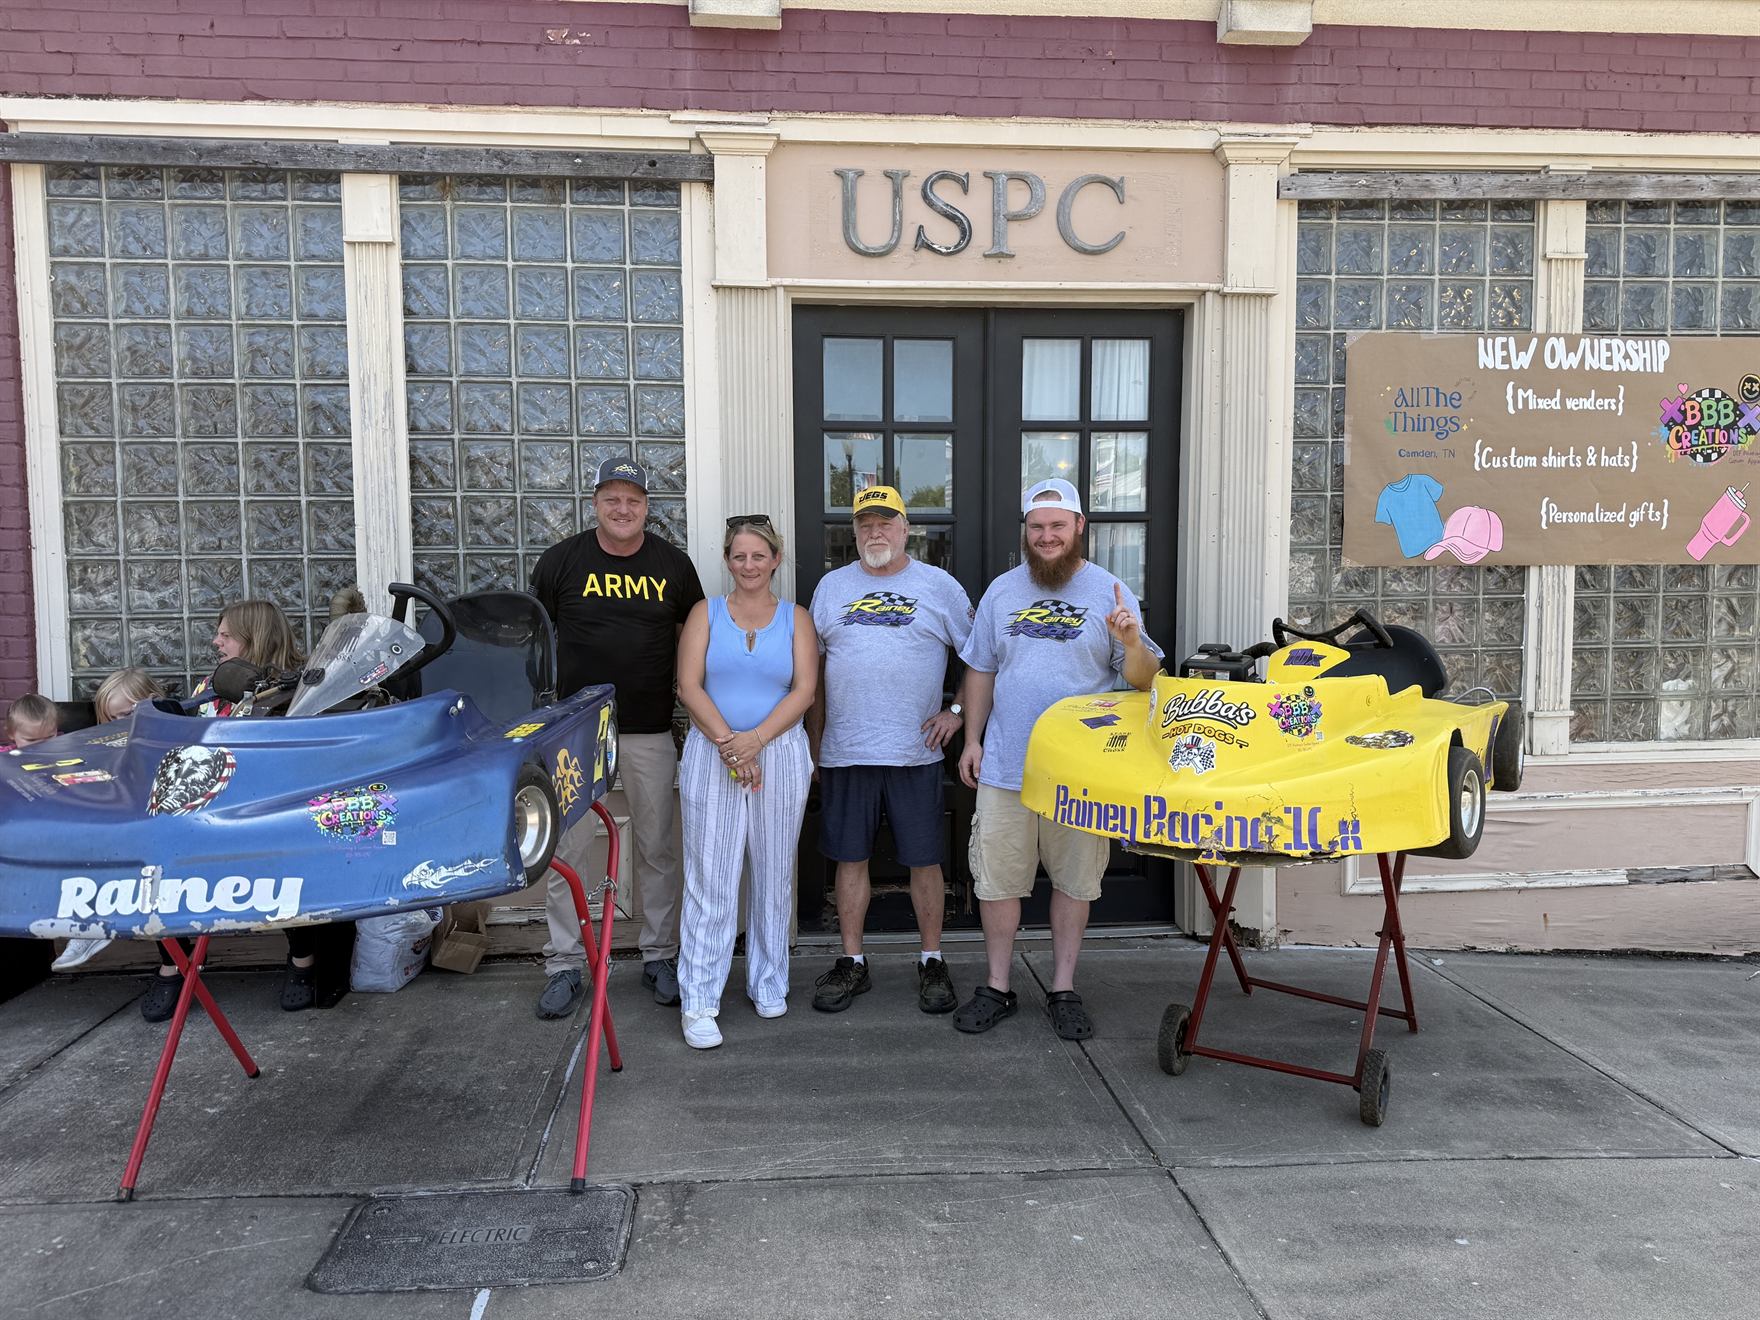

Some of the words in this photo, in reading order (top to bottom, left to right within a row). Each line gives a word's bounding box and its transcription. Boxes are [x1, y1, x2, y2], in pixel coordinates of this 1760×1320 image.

[834, 168, 1125, 258] USPC
[1478, 336, 1538, 370] NEW
[1544, 337, 1671, 373] OWNERSHIP
[1388, 411, 1461, 440] Things
[1398, 448, 1438, 459] Camden,
[1443, 449, 1456, 458] TN
[1541, 446, 1582, 468] shirts
[1586, 445, 1598, 467] &
[582, 573, 667, 602] ARMY
[848, 598, 915, 616] Rainey
[1014, 608, 1086, 628] Rainey
[1162, 689, 1257, 729] Bubba's
[1169, 723, 1192, 738] HOT
[1193, 723, 1235, 745] DOGS
[1053, 784, 1137, 846] Rainey
[57, 865, 304, 922] Rainey
[438, 1226, 526, 1245] ELECTRIC
